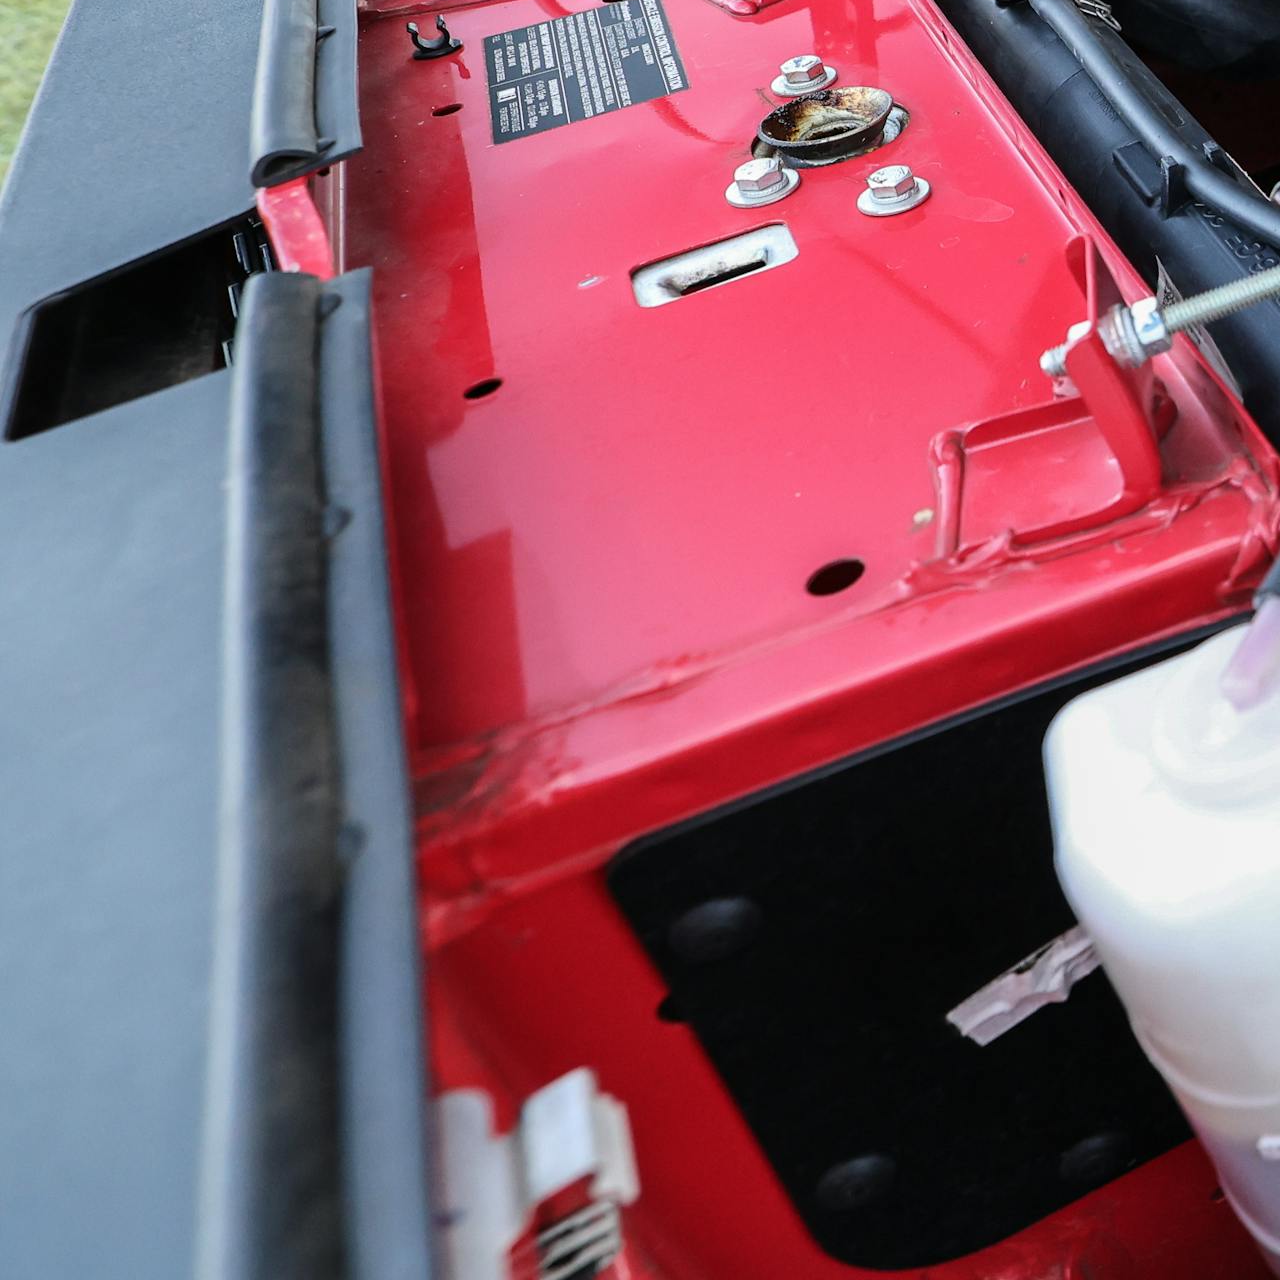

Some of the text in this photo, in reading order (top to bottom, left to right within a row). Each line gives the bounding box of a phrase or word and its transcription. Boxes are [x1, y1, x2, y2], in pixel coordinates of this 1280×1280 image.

[648, 14, 665, 36] EMISSION
[654, 34, 672, 58] CONTROL
[661, 55, 682, 90] INFORMATION
